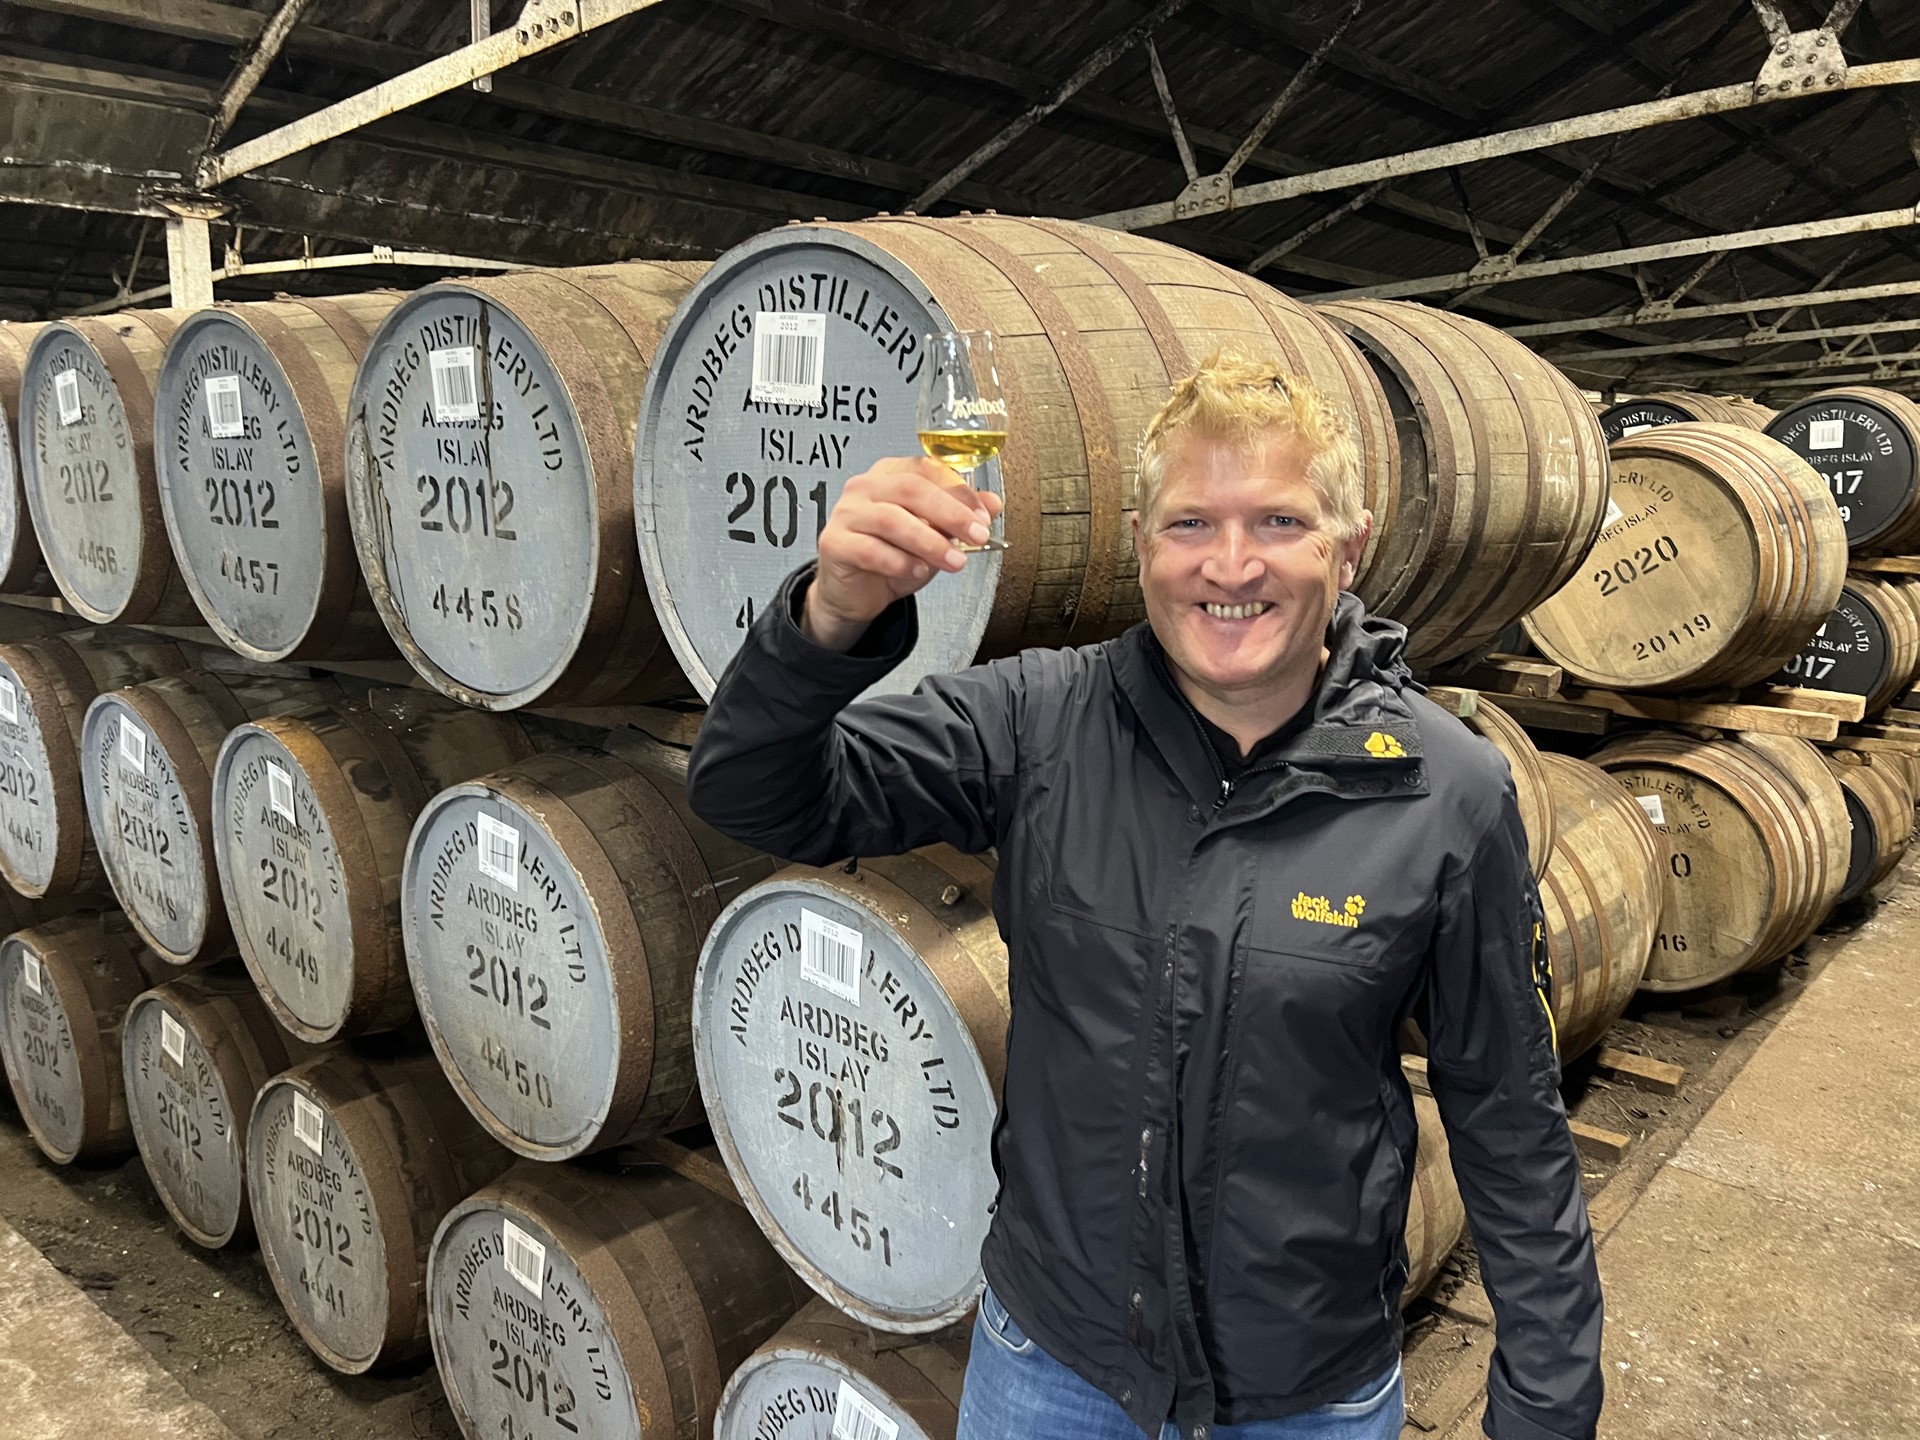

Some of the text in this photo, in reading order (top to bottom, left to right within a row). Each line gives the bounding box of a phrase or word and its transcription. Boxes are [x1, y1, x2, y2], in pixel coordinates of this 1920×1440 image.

[178, 367, 199, 473] ARDBEG
[199, 345, 280, 414] DISTILLERY
[378, 342, 421, 471] ARDBEG
[684, 304, 752, 463] ARDBEG
[56, 404, 96, 431] AEG
[202, 415, 262, 440] AEG
[422, 401, 505, 431] AEG
[1620, 411, 1679, 427] DISTILLE
[1782, 409, 1894, 456] BEG DISTILLERY LTD
[211, 446, 253, 473] ISLAY
[437, 437, 492, 469] ISLAY
[760, 427, 850, 470] ISLAY
[1805, 452, 1873, 466] DBEG ISLAY
[60, 459, 113, 504] 2012
[206, 477, 279, 529] 2012
[1649, 481, 1674, 502] LTD
[1822, 469, 1864, 495] 17
[417, 474, 518, 541] 2012
[725, 471, 828, 549] 201
[1597, 503, 1658, 545] BEG ISLAY
[221, 551, 279, 596] 4457
[1593, 535, 1679, 597] 2020
[1632, 613, 1712, 662] 20119
[1818, 639, 1852, 653] ISLAY
[1782, 653, 1836, 680] 017
[233, 762, 259, 846] ARDBEG
[1618, 776, 1711, 829] STILLERY LTD
[8, 817, 42, 852] 4447
[121, 808, 174, 868] 2012
[271, 835, 307, 870] ISLAY
[260, 858, 324, 932] 2012
[430, 829, 466, 931] ARDBEG
[1292, 891, 1330, 911] Jack
[467, 882, 538, 933] ARDBEG
[1291, 903, 1359, 928] Wolfskin
[266, 926, 319, 985] 4449
[480, 917, 525, 959] ISLAY
[466, 944, 551, 1031] 2012
[730, 931, 782, 1047] ARDBEG
[780, 995, 889, 1062] ARDBEG
[480, 1036, 553, 1109] 4450
[797, 1038, 871, 1093] ISLAY
[158, 1091, 203, 1161] 2012
[208, 1097, 225, 1136] LTD
[774, 1067, 904, 1179] 2012
[267, 1108, 288, 1185] ARDBEG
[288, 1150, 342, 1192] ARDBEG
[297, 1179, 334, 1213] ISLAY
[791, 1171, 892, 1267] 4451
[292, 1203, 353, 1267] 2012
[456, 1236, 492, 1320] ARDBEG
[493, 1286, 566, 1346] ARDBEG
[506, 1320, 551, 1367] ISLAY
[489, 1339, 578, 1434] 2012
[755, 1388, 806, 1440] DBEG
